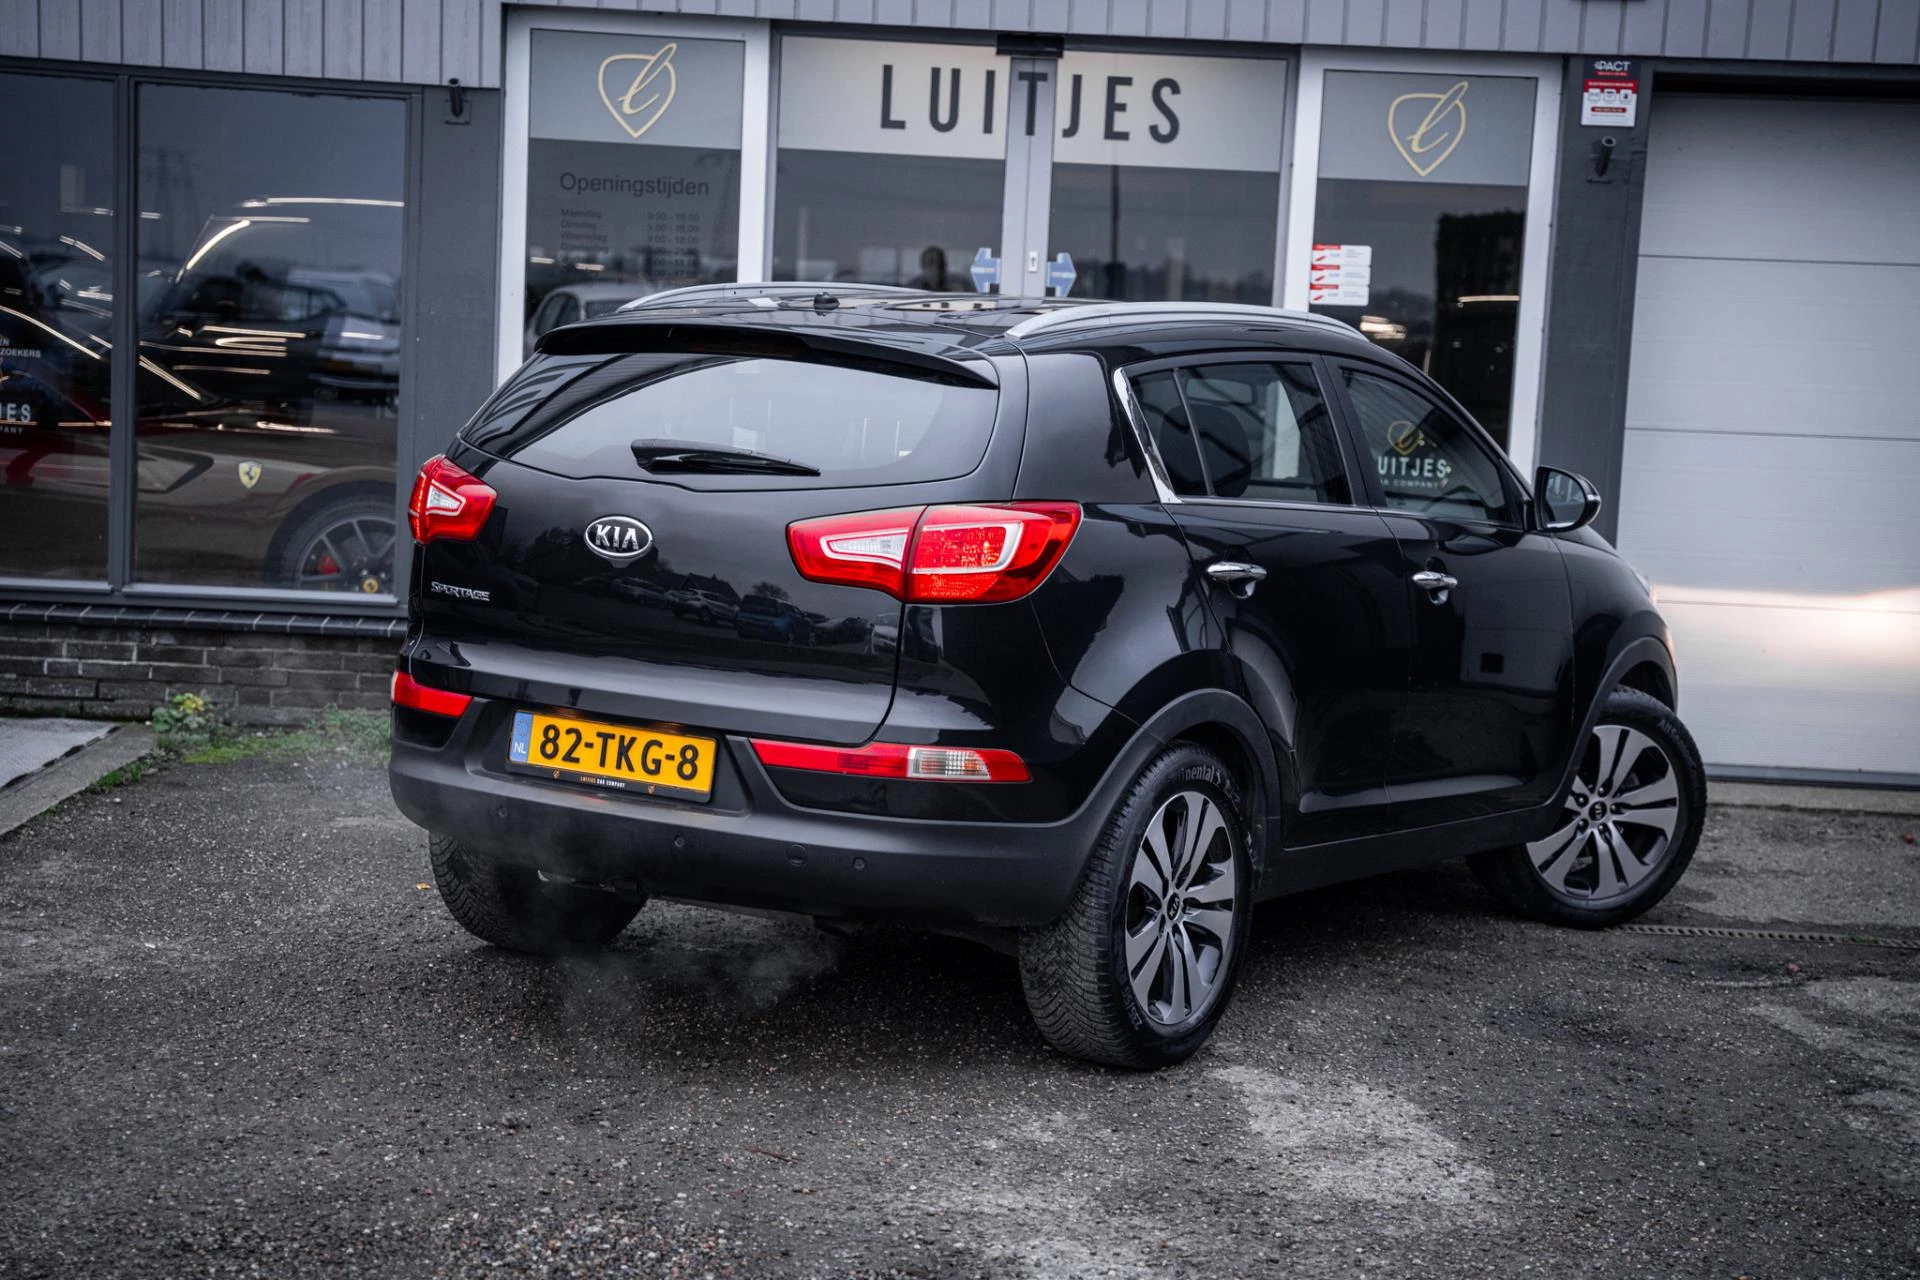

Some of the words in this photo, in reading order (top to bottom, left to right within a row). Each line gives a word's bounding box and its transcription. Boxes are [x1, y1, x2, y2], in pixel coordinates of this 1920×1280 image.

[880, 64, 1181, 144] LUITJES
[559, 172, 709, 198] Openingstijden
[1377, 456, 1446, 478] UITJES
[595, 524, 640, 550] KIA
[431, 581, 490, 602] SPORTAGE
[513, 742, 527, 754] NL
[539, 724, 699, 781] 82-TKG-8
